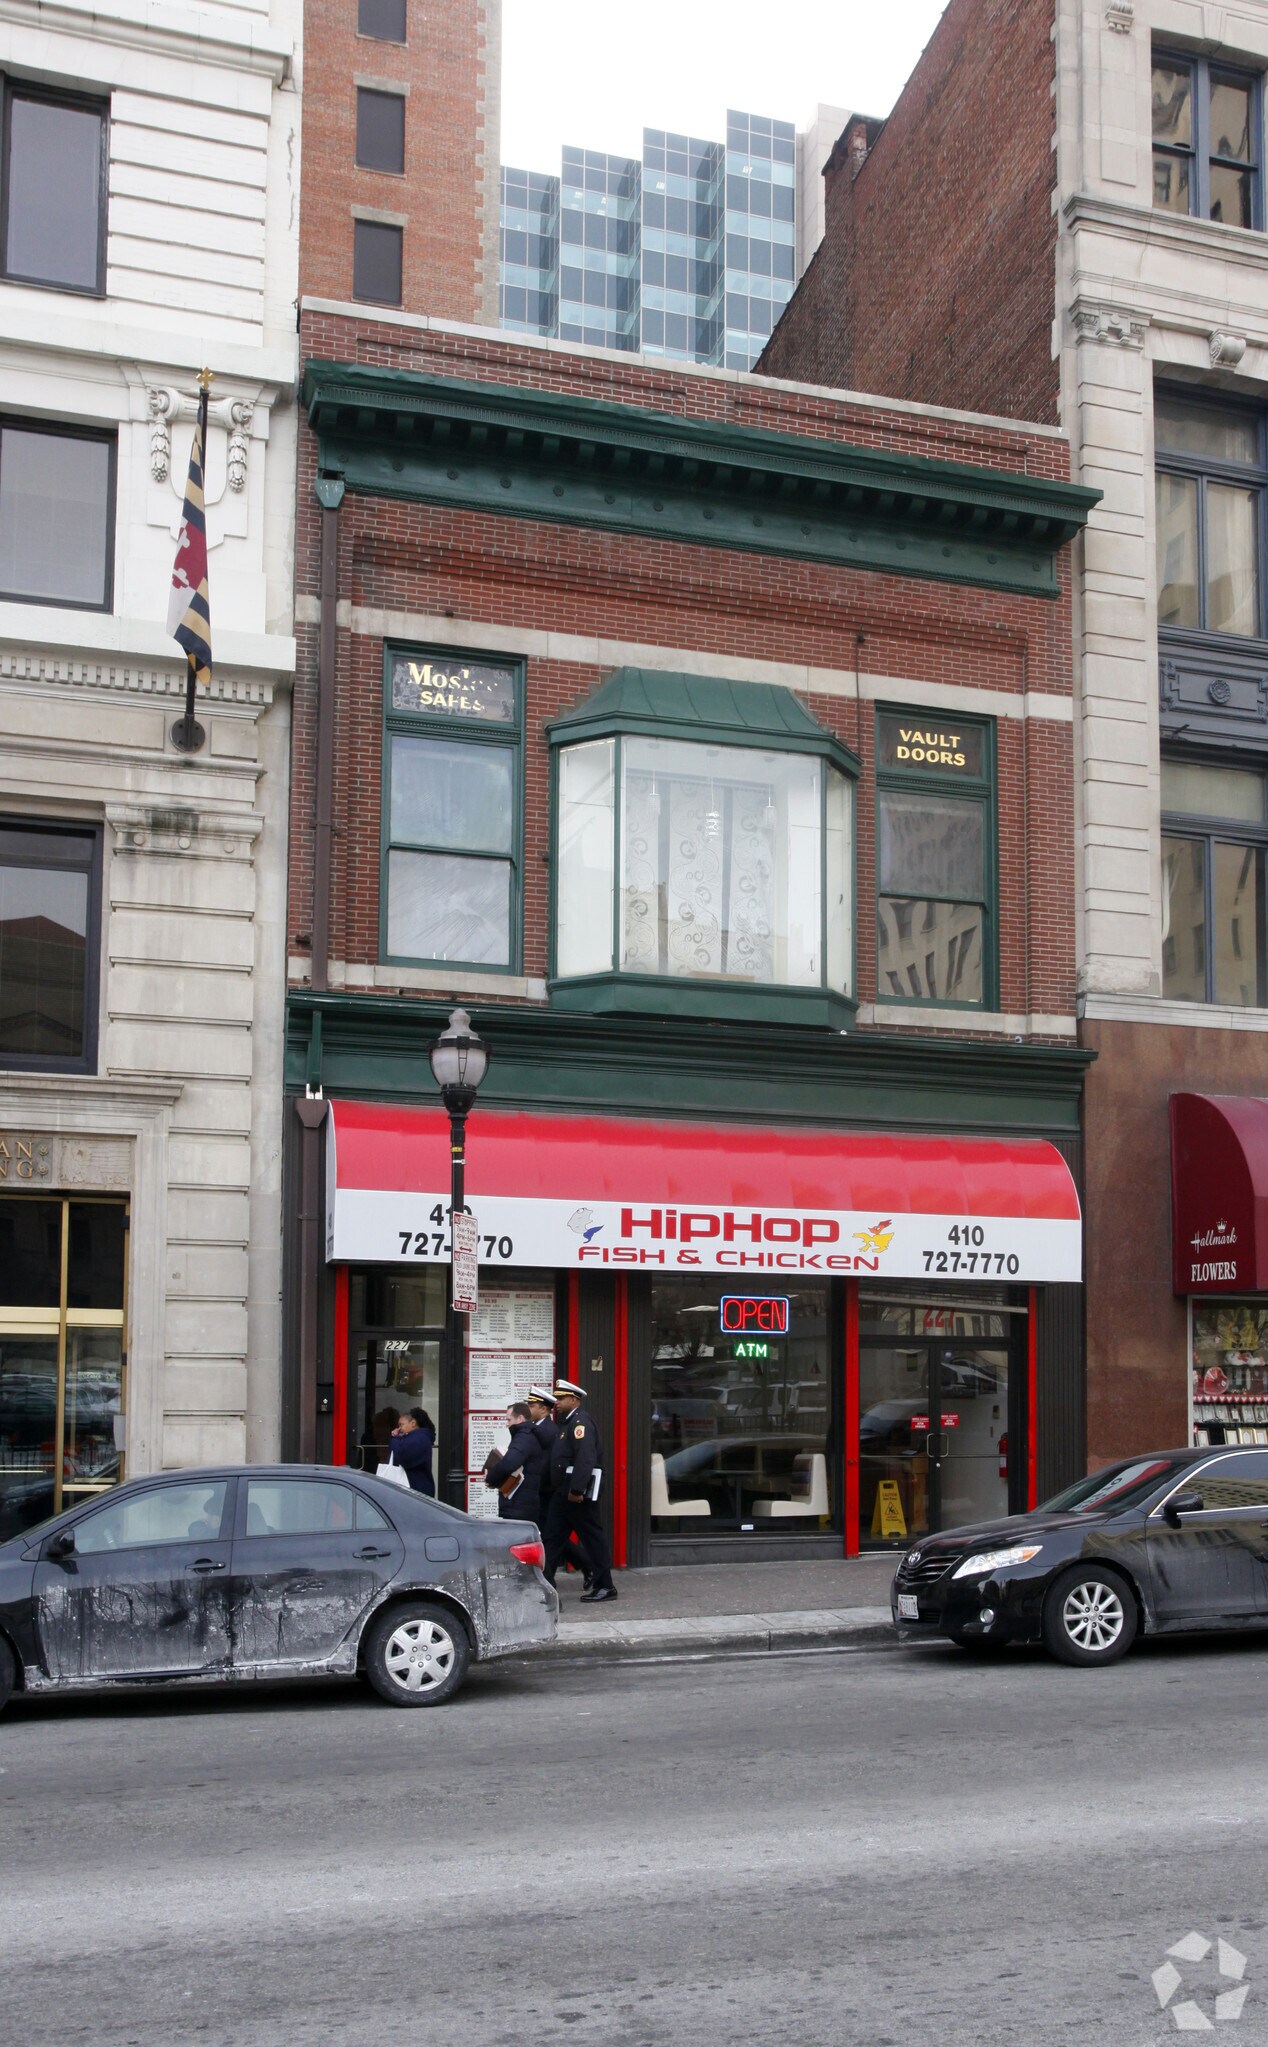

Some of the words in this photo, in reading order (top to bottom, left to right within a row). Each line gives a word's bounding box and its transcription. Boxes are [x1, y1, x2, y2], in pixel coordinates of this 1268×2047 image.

[899, 729, 961, 748] VAULT
[897, 746, 966, 767] DOORS
[620, 1208, 840, 1247] HipHop
[948, 1225, 985, 1247] 410
[1190, 1227, 1237, 1254] Hallmark
[578, 1246, 665, 1264] FISH
[676, 1249, 703, 1265] &
[922, 1250, 1020, 1275] 727-7770
[1191, 1261, 1237, 1282] FLOWERS
[723, 1299, 786, 1331] OPEN
[386, 1340, 409, 1350] 227
[735, 1343, 767, 1358] ATM
